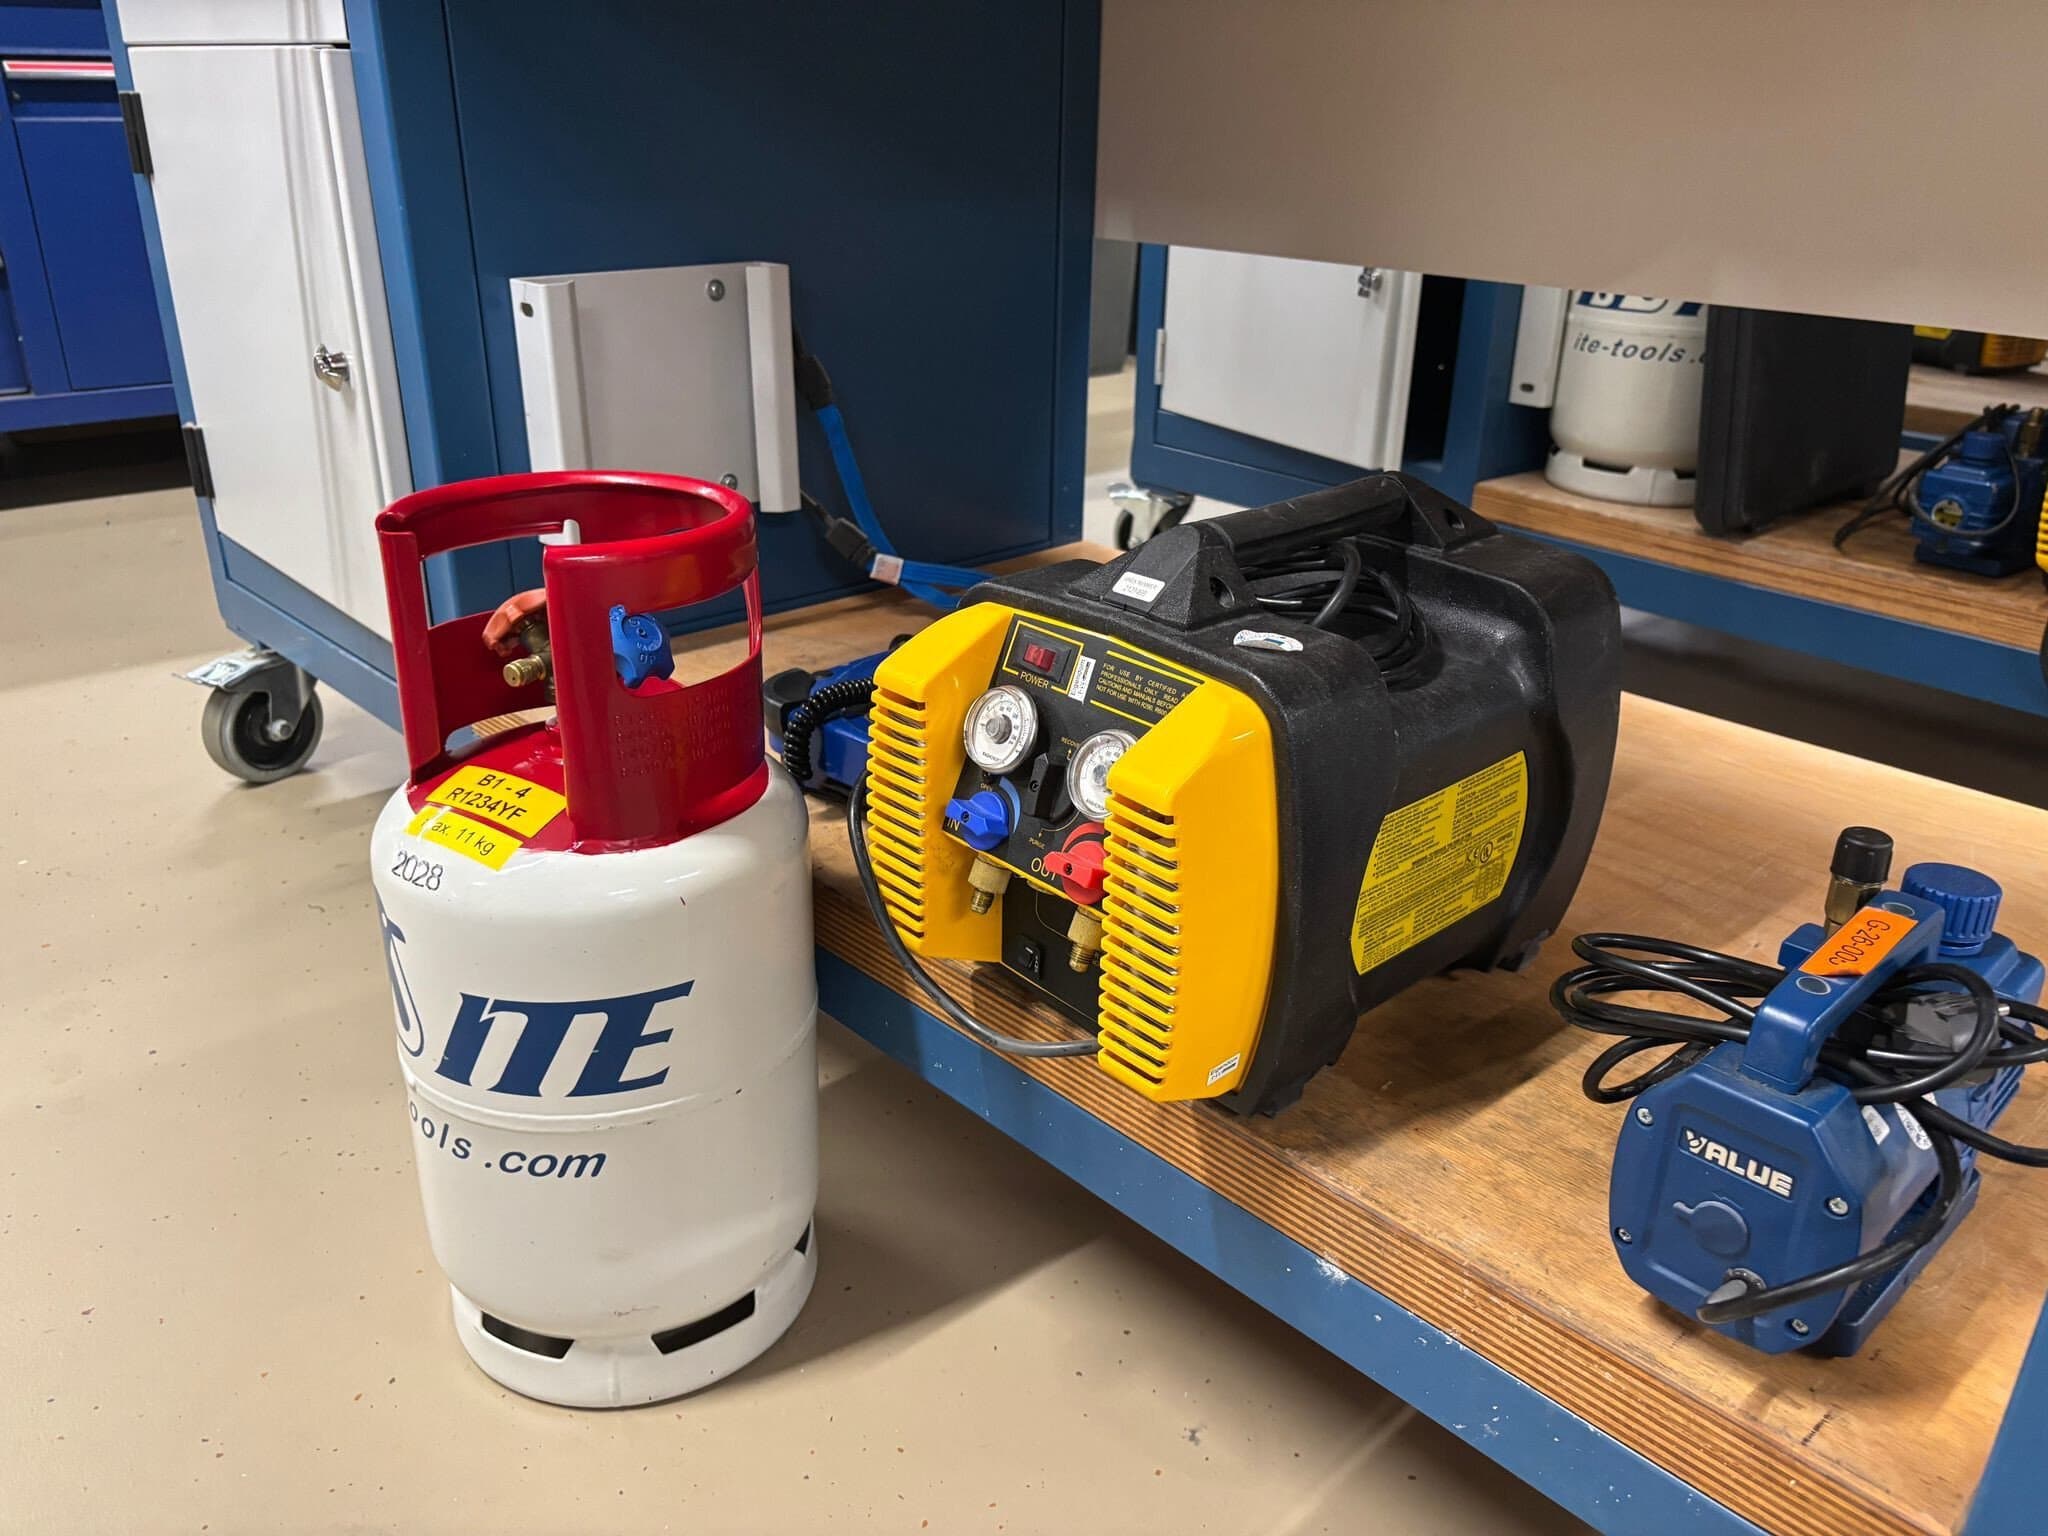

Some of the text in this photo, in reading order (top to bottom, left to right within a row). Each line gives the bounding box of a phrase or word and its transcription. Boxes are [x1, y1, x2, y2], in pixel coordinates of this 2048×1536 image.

[1020, 671, 1049, 689] POWER
[1103, 662, 1115, 672] FOR
[1119, 668, 1131, 678] USE
[1147, 679, 1177, 695] CERTIFIED
[477, 774, 506, 789] B1
[515, 787, 532, 799] 4
[446, 787, 528, 820] R1234YF
[456, 828, 472, 844] 11
[474, 836, 496, 857] kg
[391, 850, 444, 892] 2028
[433, 979, 696, 1099] ITE
[1685, 1128, 1793, 1198] VALUE
